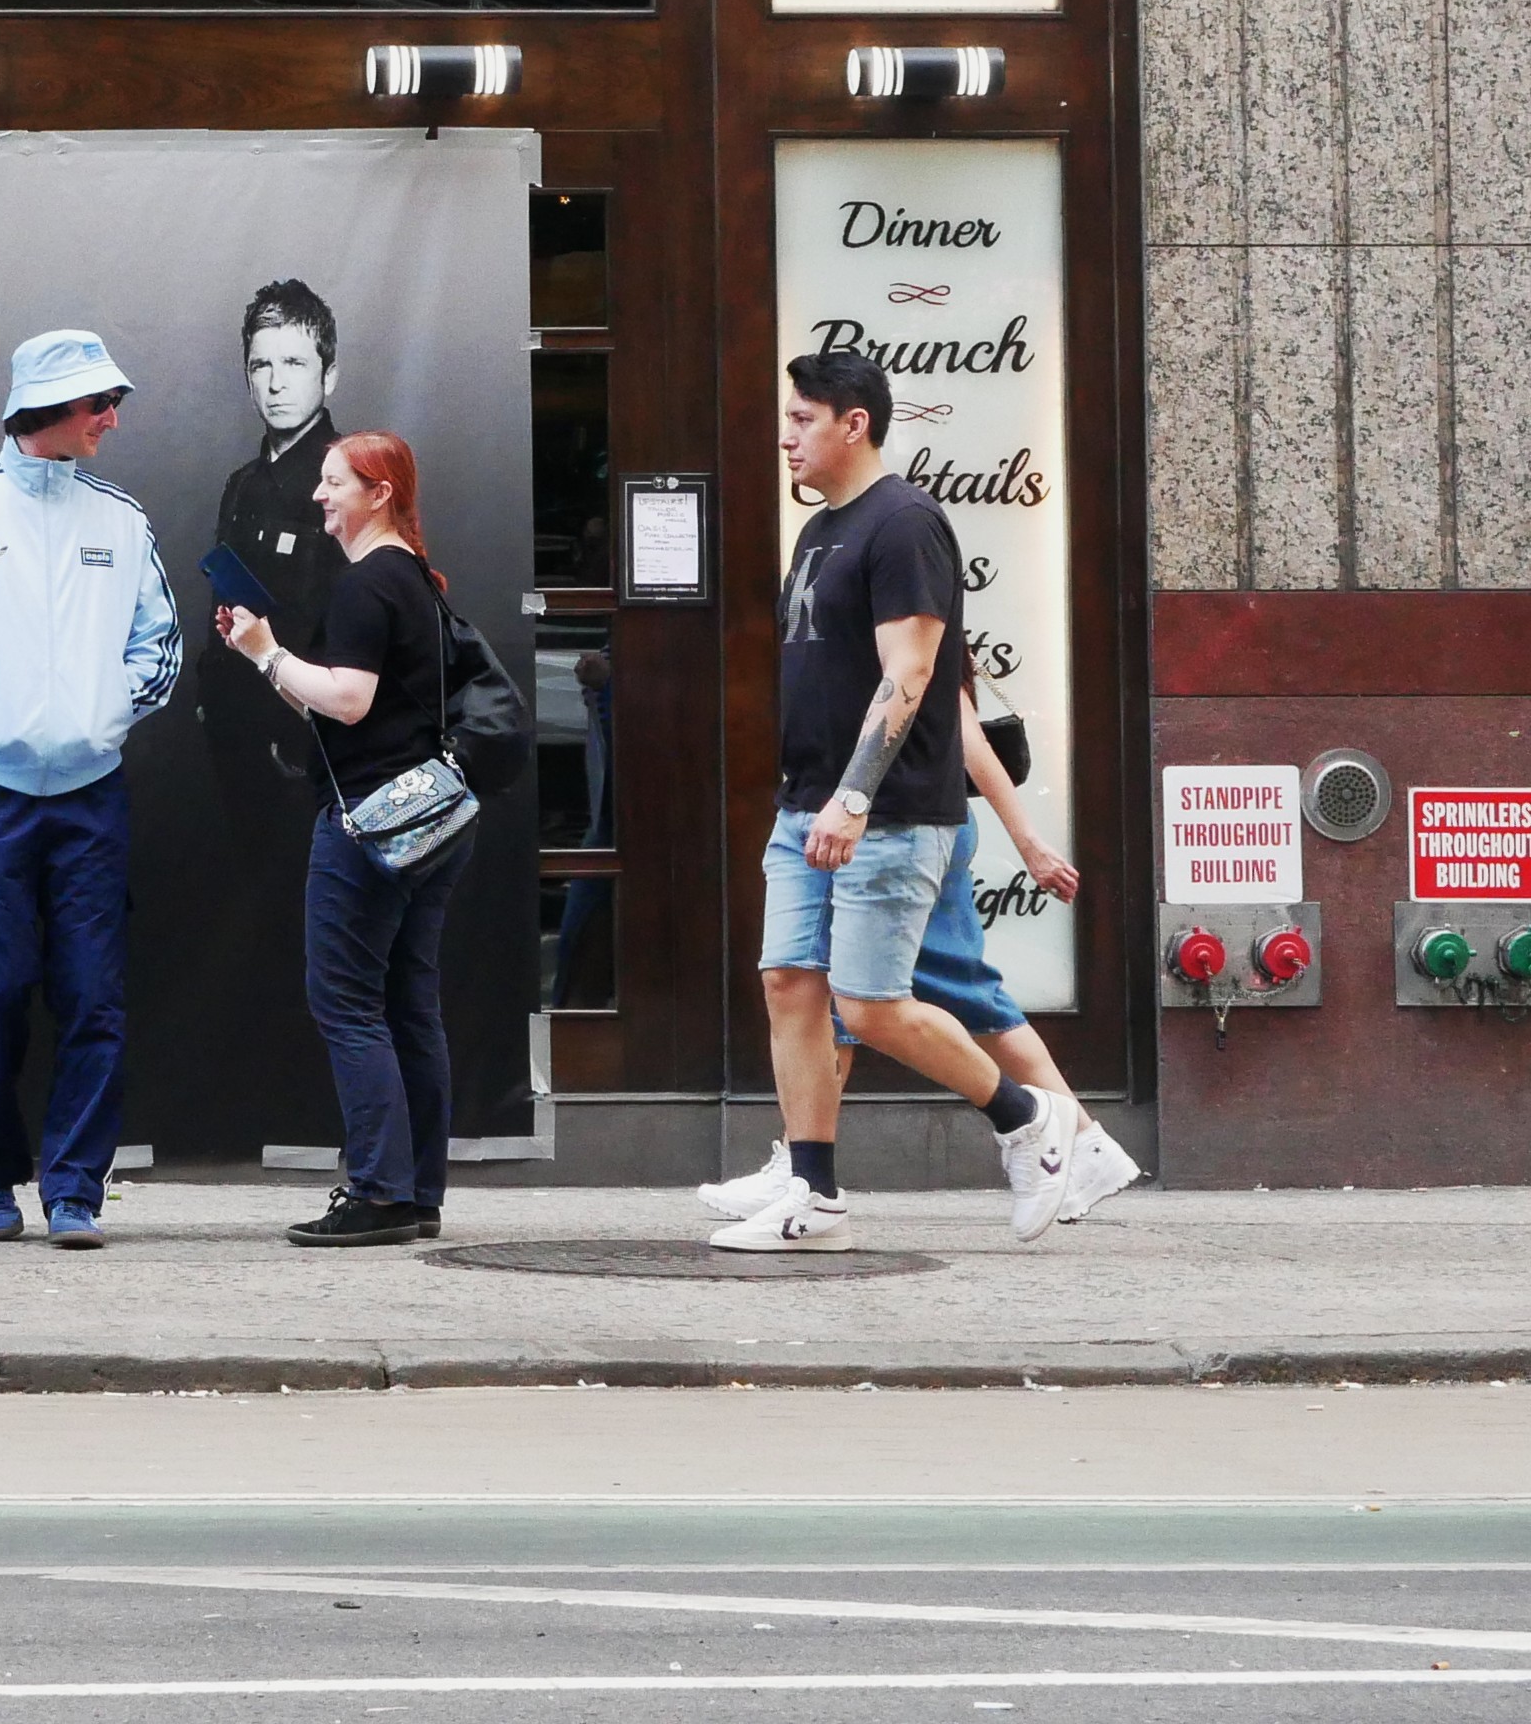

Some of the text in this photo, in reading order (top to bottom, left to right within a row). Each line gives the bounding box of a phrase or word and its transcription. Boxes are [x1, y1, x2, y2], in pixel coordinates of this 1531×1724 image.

[839, 201, 1001, 248] Dinner
[811, 315, 1035, 374] Brunch
[791, 447, 1051, 507] ktails
[1181, 786, 1283, 811] STANDPIPE
[1422, 801, 1531, 828] SPRINKLERS
[1173, 822, 1293, 847] THROUGHOUT
[1191, 859, 1277, 883] BUILDING
[1436, 863, 1520, 888] BUILDING
